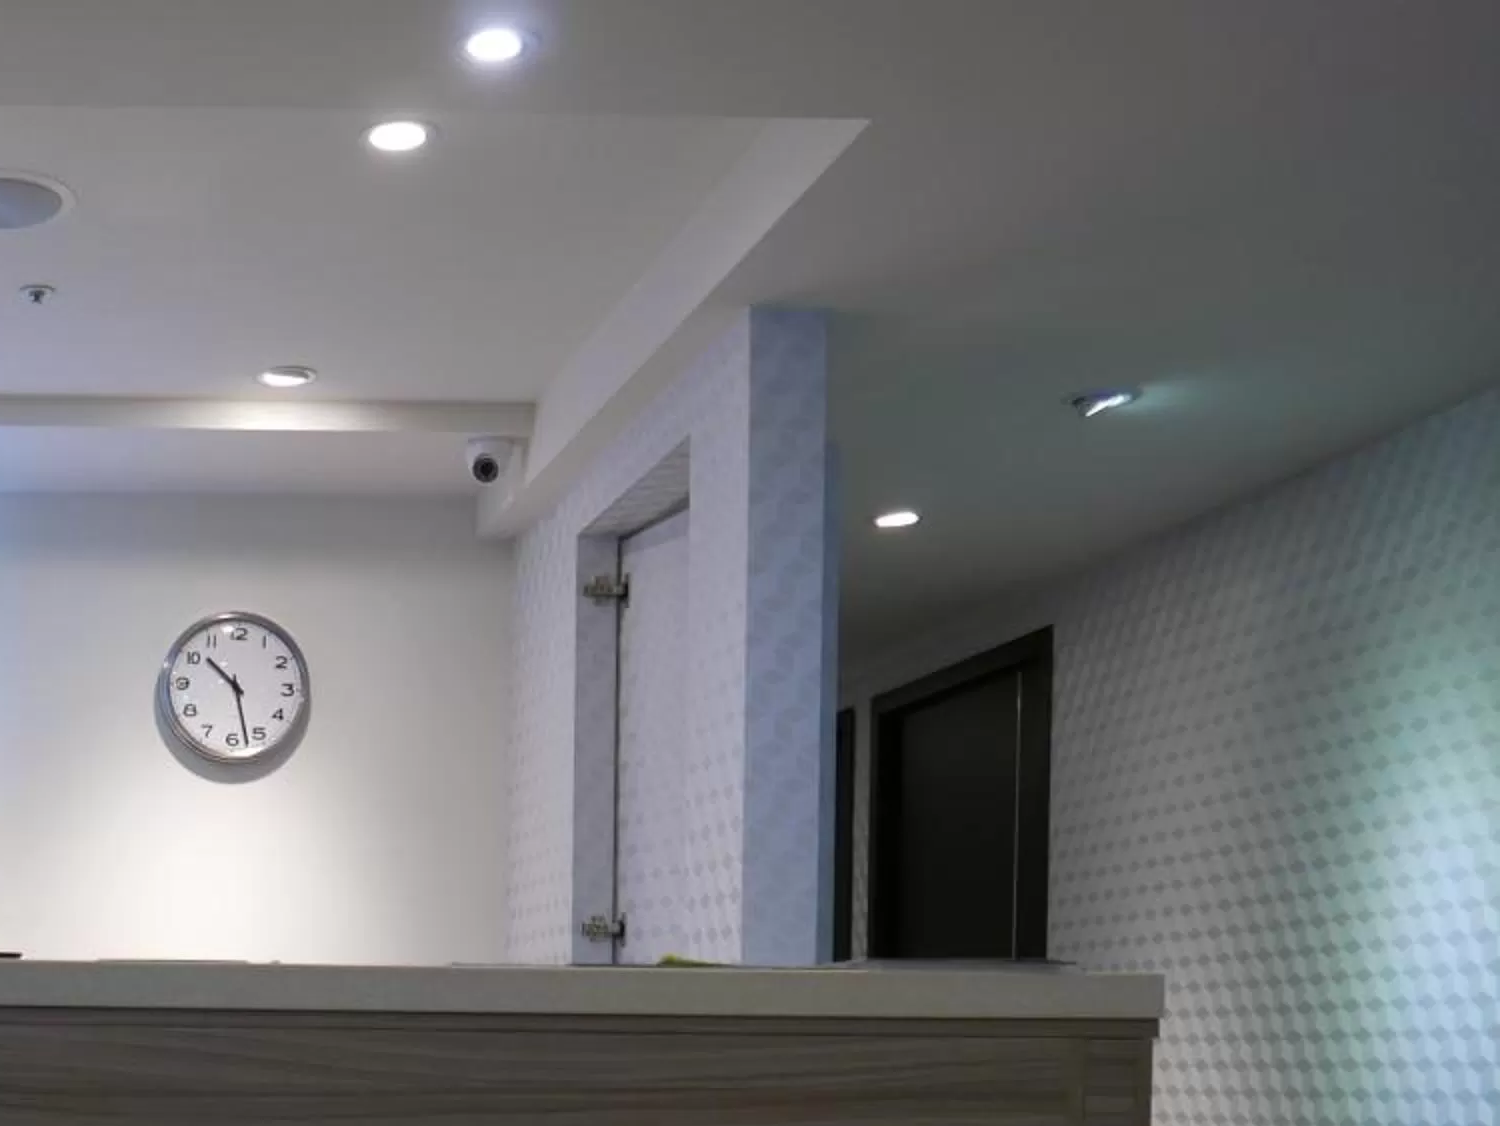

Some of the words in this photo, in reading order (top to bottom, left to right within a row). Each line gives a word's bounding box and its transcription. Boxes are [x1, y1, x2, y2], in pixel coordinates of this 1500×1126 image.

[206, 634, 217, 648] 11
[230, 627, 248, 641] 12
[262, 635, 267, 649] 1
[187, 651, 200, 665] 10
[275, 655, 288, 669] 2
[175, 676, 190, 691] 9
[280, 683, 295, 697] 3
[183, 703, 197, 717] 8
[272, 708, 284, 720] 4
[201, 724, 213, 738] 7
[251, 727, 267, 741] 5
[225, 733, 239, 747] 6
